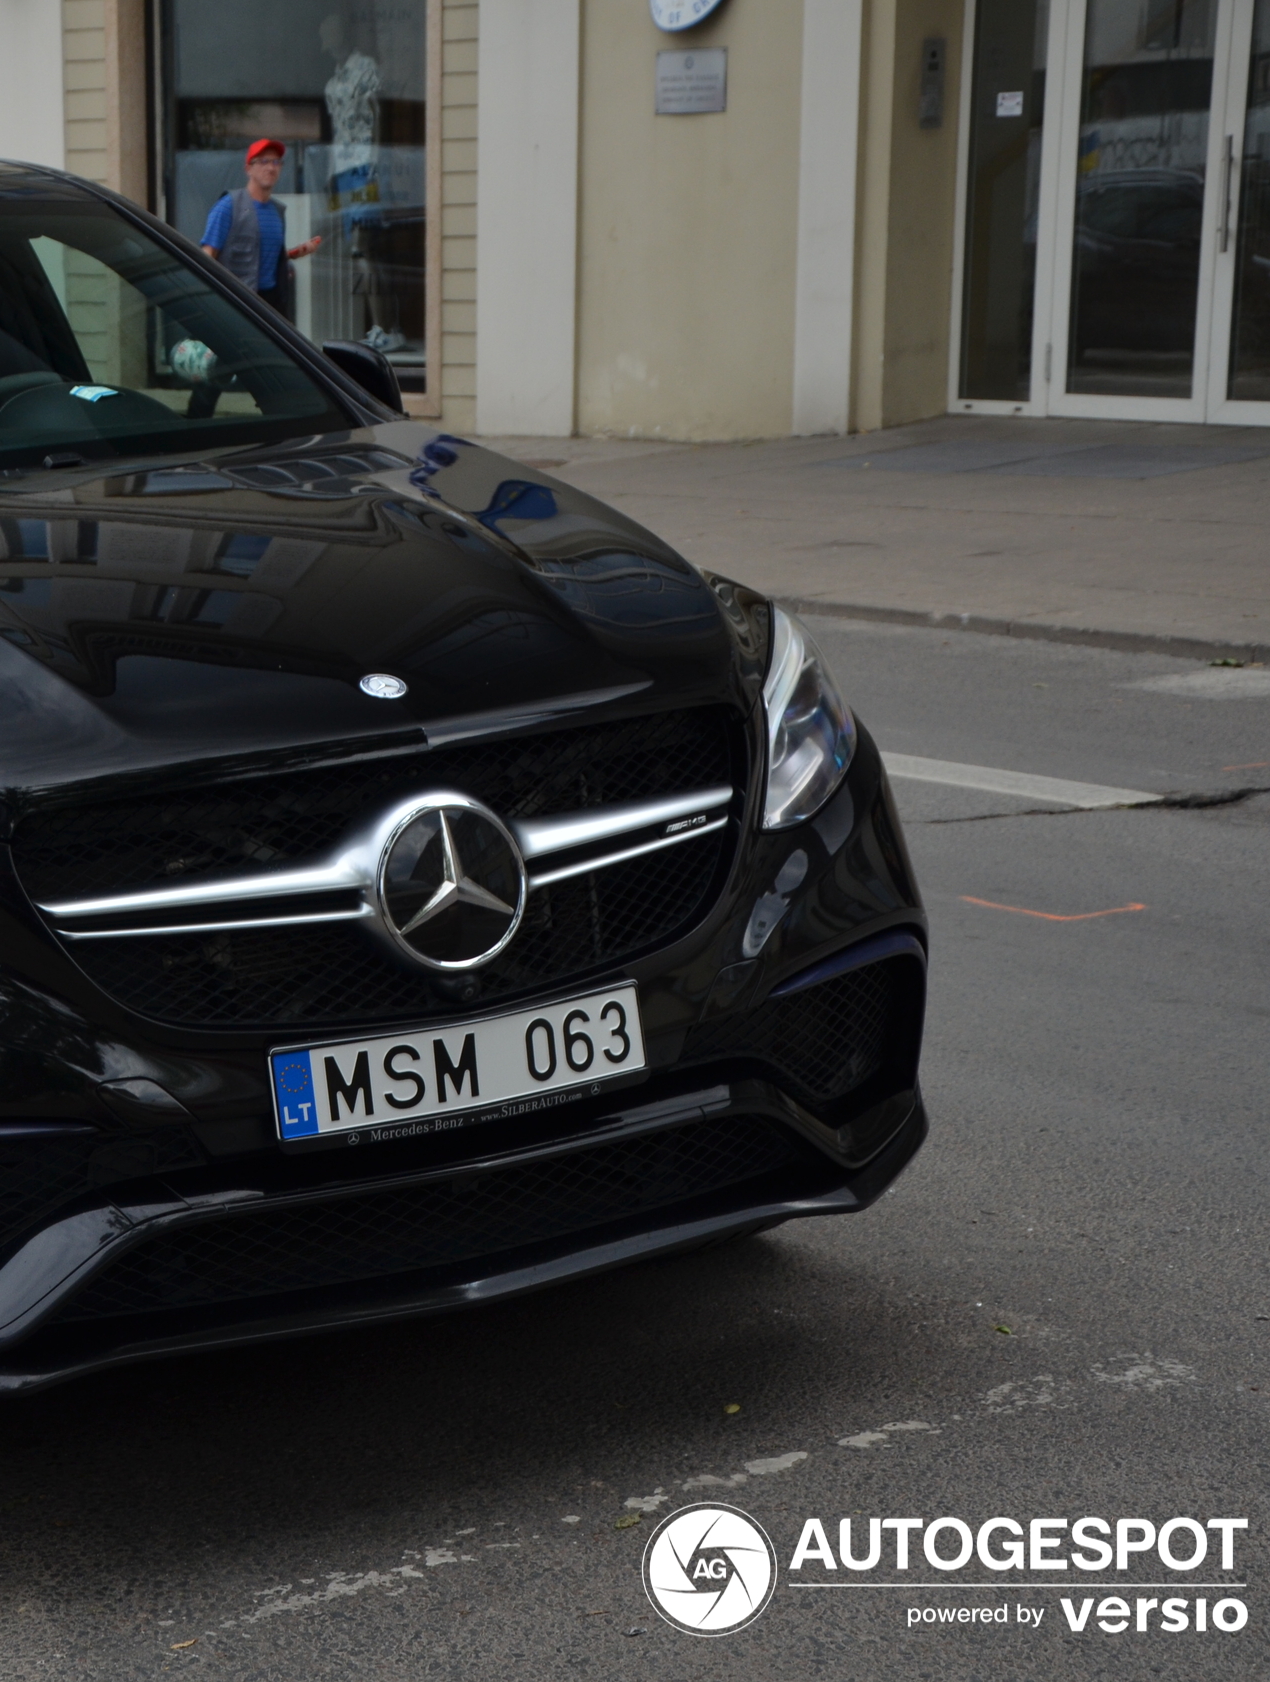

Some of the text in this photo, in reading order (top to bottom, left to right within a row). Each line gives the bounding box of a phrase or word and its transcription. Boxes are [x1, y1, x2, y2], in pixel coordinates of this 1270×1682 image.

[323, 1000, 632, 1122] MSM 063
[283, 1102, 311, 1125] LT
[370, 1117, 464, 1142] Mercedes-Benz
